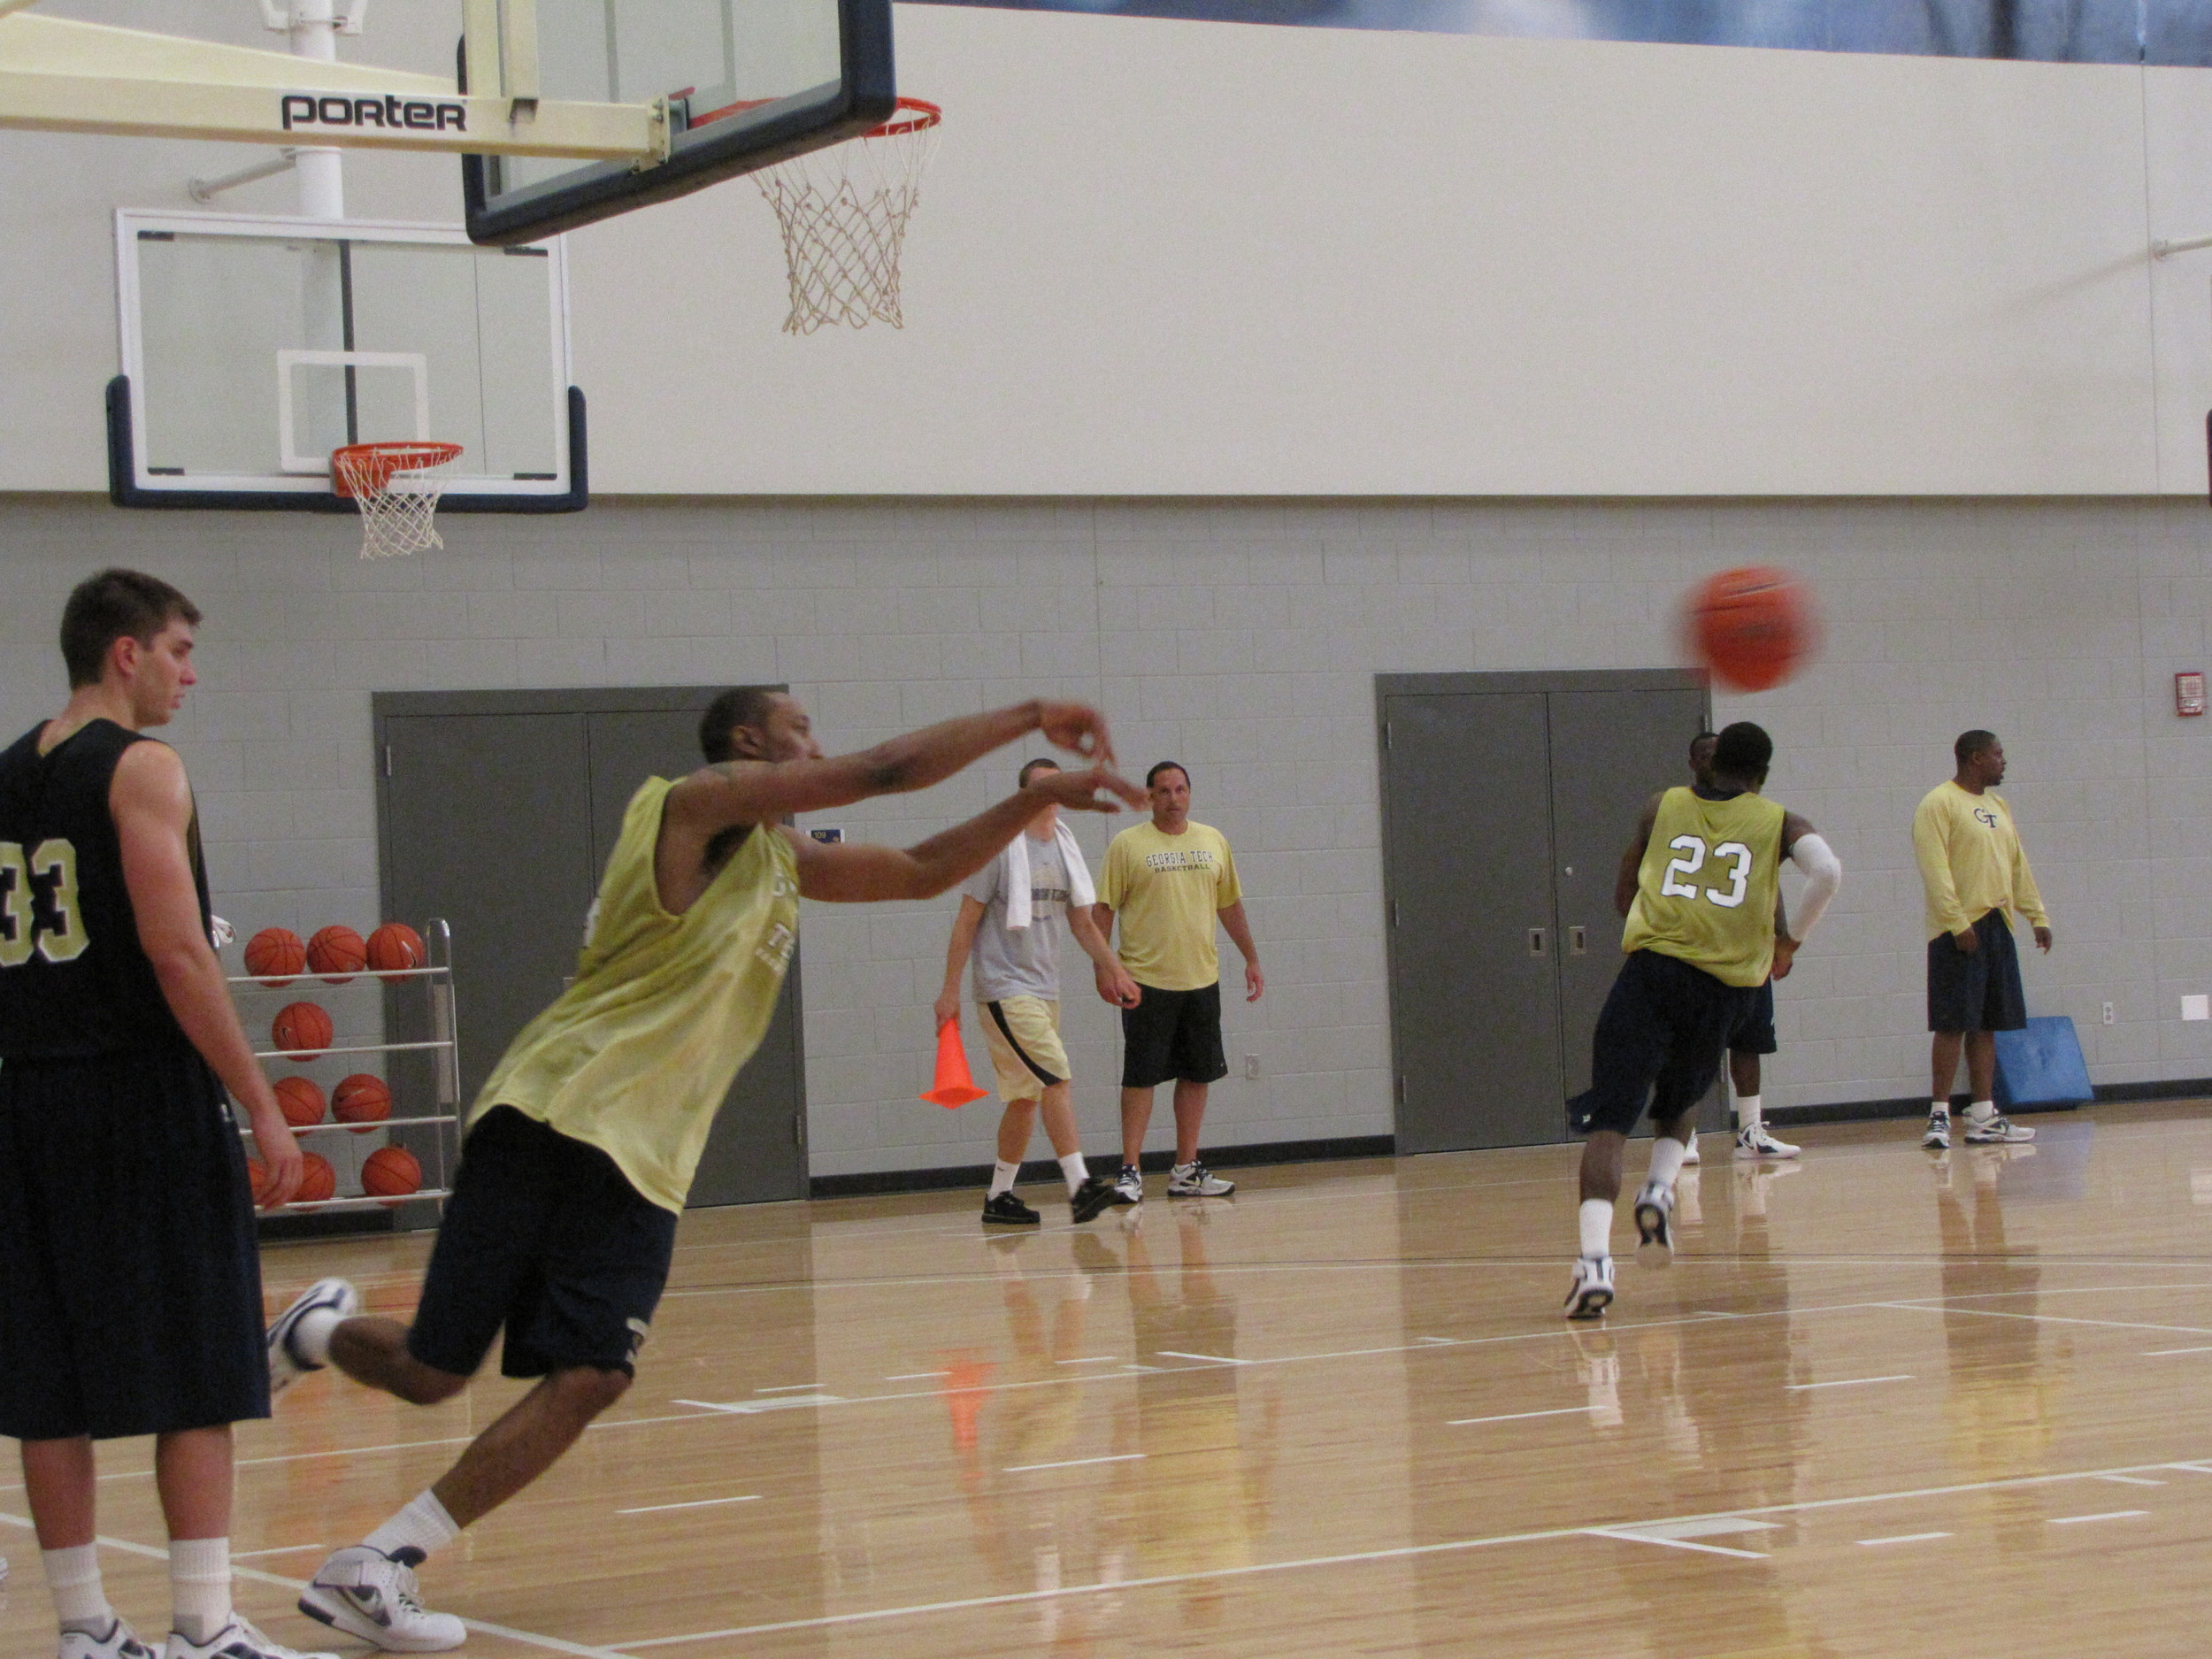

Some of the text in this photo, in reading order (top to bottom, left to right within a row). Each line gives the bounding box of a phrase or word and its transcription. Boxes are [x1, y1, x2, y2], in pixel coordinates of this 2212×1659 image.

[1146, 850, 1214, 867] GEORGIA TECH
[1155, 864, 1210, 873] BASKETBALL
[1662, 833, 1753, 908] 23
[0, 838, 90, 966] 33
